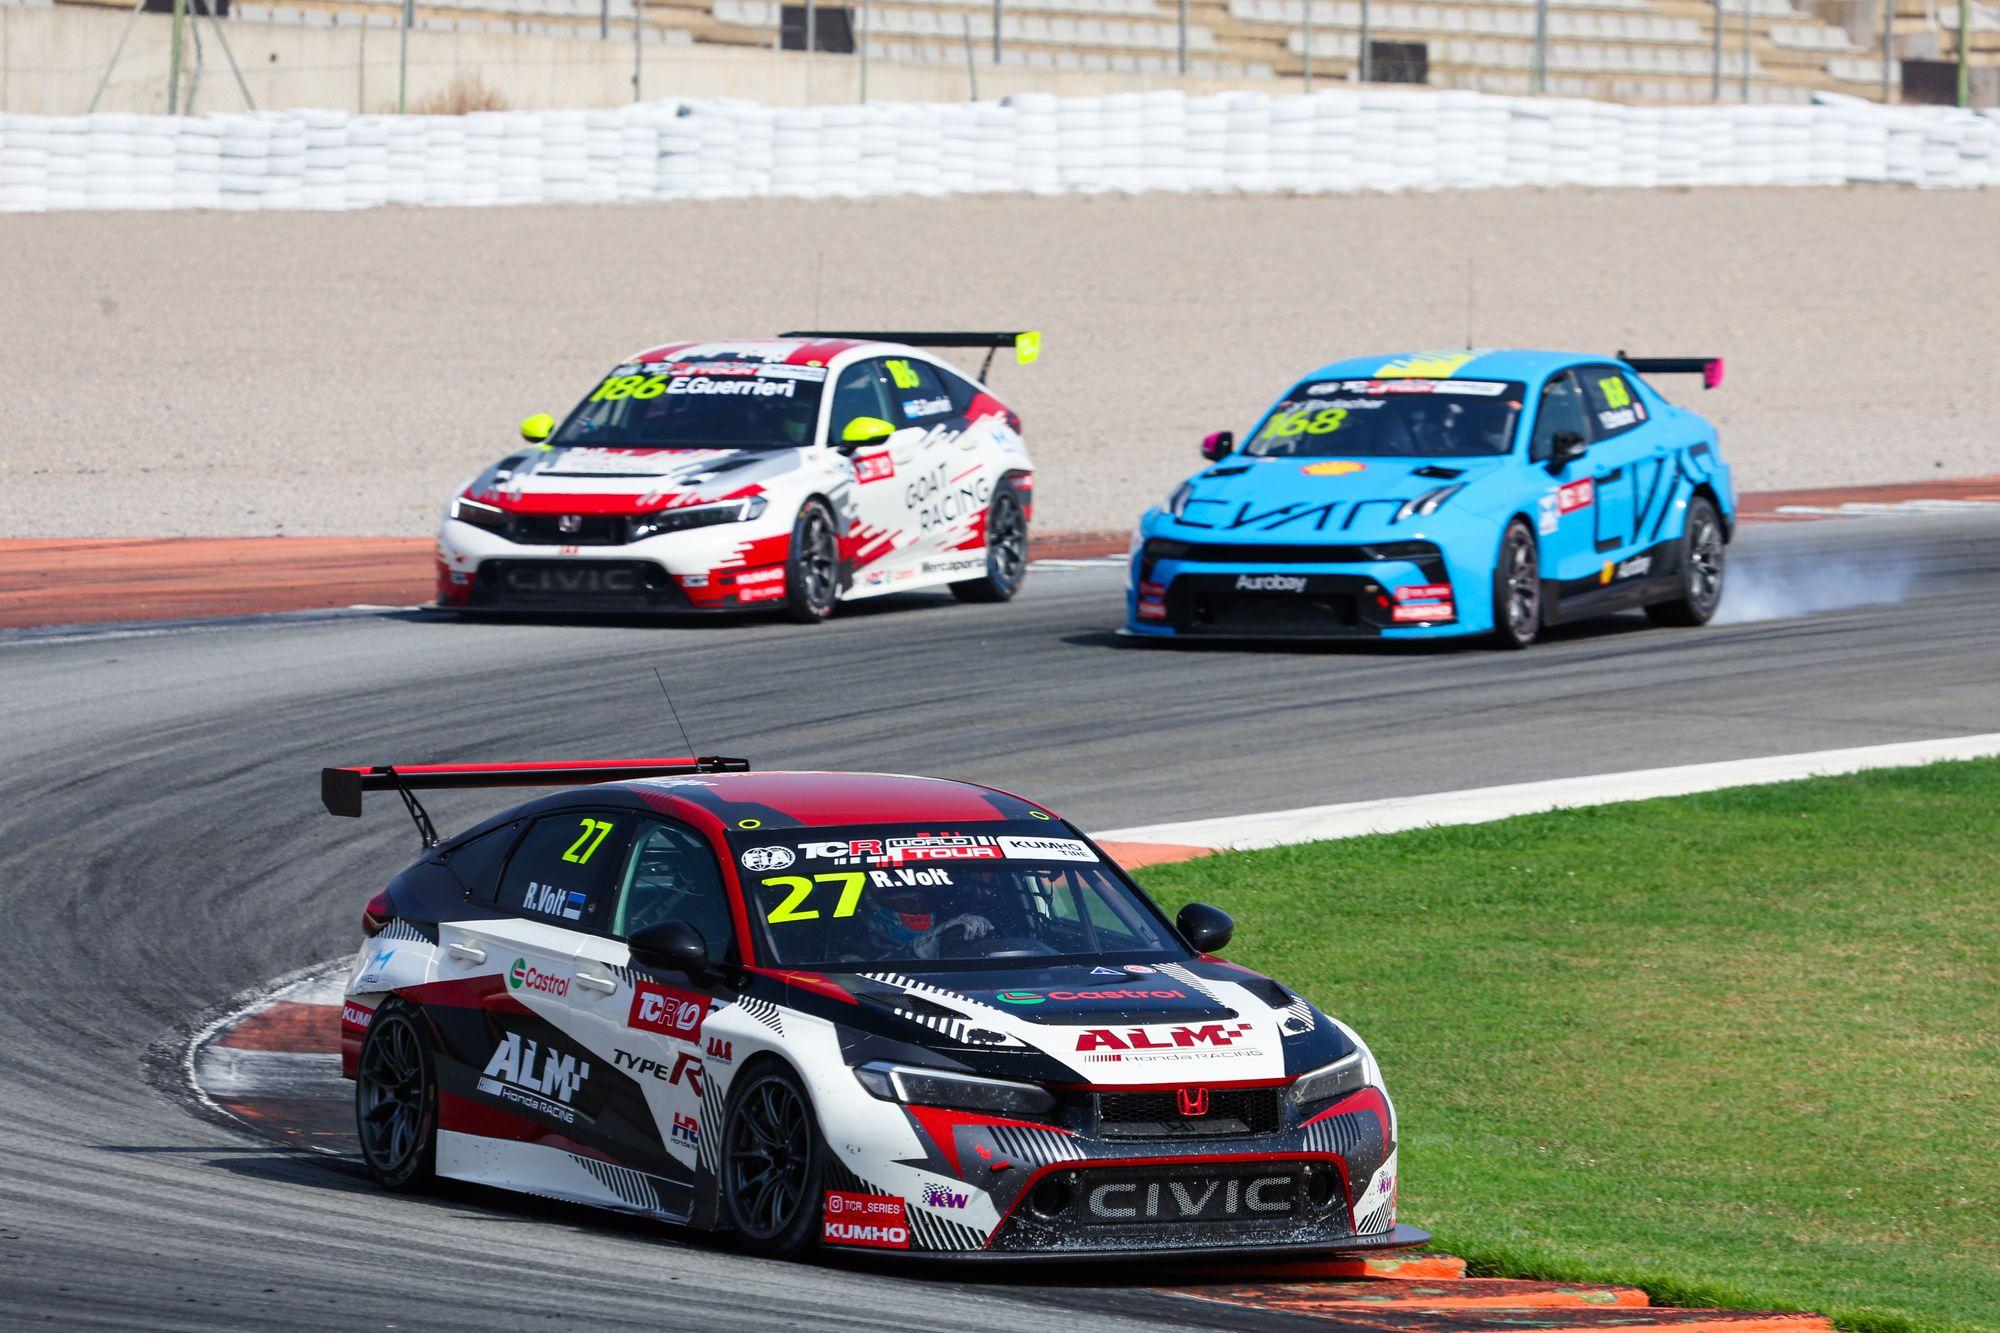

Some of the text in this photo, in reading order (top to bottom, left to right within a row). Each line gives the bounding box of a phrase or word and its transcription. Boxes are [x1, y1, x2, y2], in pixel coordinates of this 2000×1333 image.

[589, 374, 670, 402] 186
[1260, 406, 1349, 440] 168
[905, 462, 947, 509] GOAT
[919, 477, 991, 533] RACING
[562, 818, 613, 865] 27
[798, 840, 883, 859] TCR
[893, 838, 975, 848] WORLD
[926, 847, 994, 859] TOUR
[1010, 840, 1082, 854] KUMHO
[1061, 848, 1089, 859] TIRE
[868, 868, 956, 889] R.Volt
[522, 881, 567, 918] R.Volt
[761, 872, 867, 924] 27
[525, 968, 570, 997] Castrol
[1048, 990, 1187, 1001] Castrol
[1075, 1024, 1236, 1051] ALM
[482, 1031, 583, 1104] ALM
[1124, 1050, 1263, 1062] Honda RACING
[614, 1048, 704, 1098] TYPE R
[502, 1088, 574, 1124] Honda RACING
[845, 1199, 901, 1215] TCR_SERIES
[929, 1190, 969, 1209] KW
[1089, 1176, 1292, 1218] CIVIC
[825, 1222, 907, 1243] KUMHO
